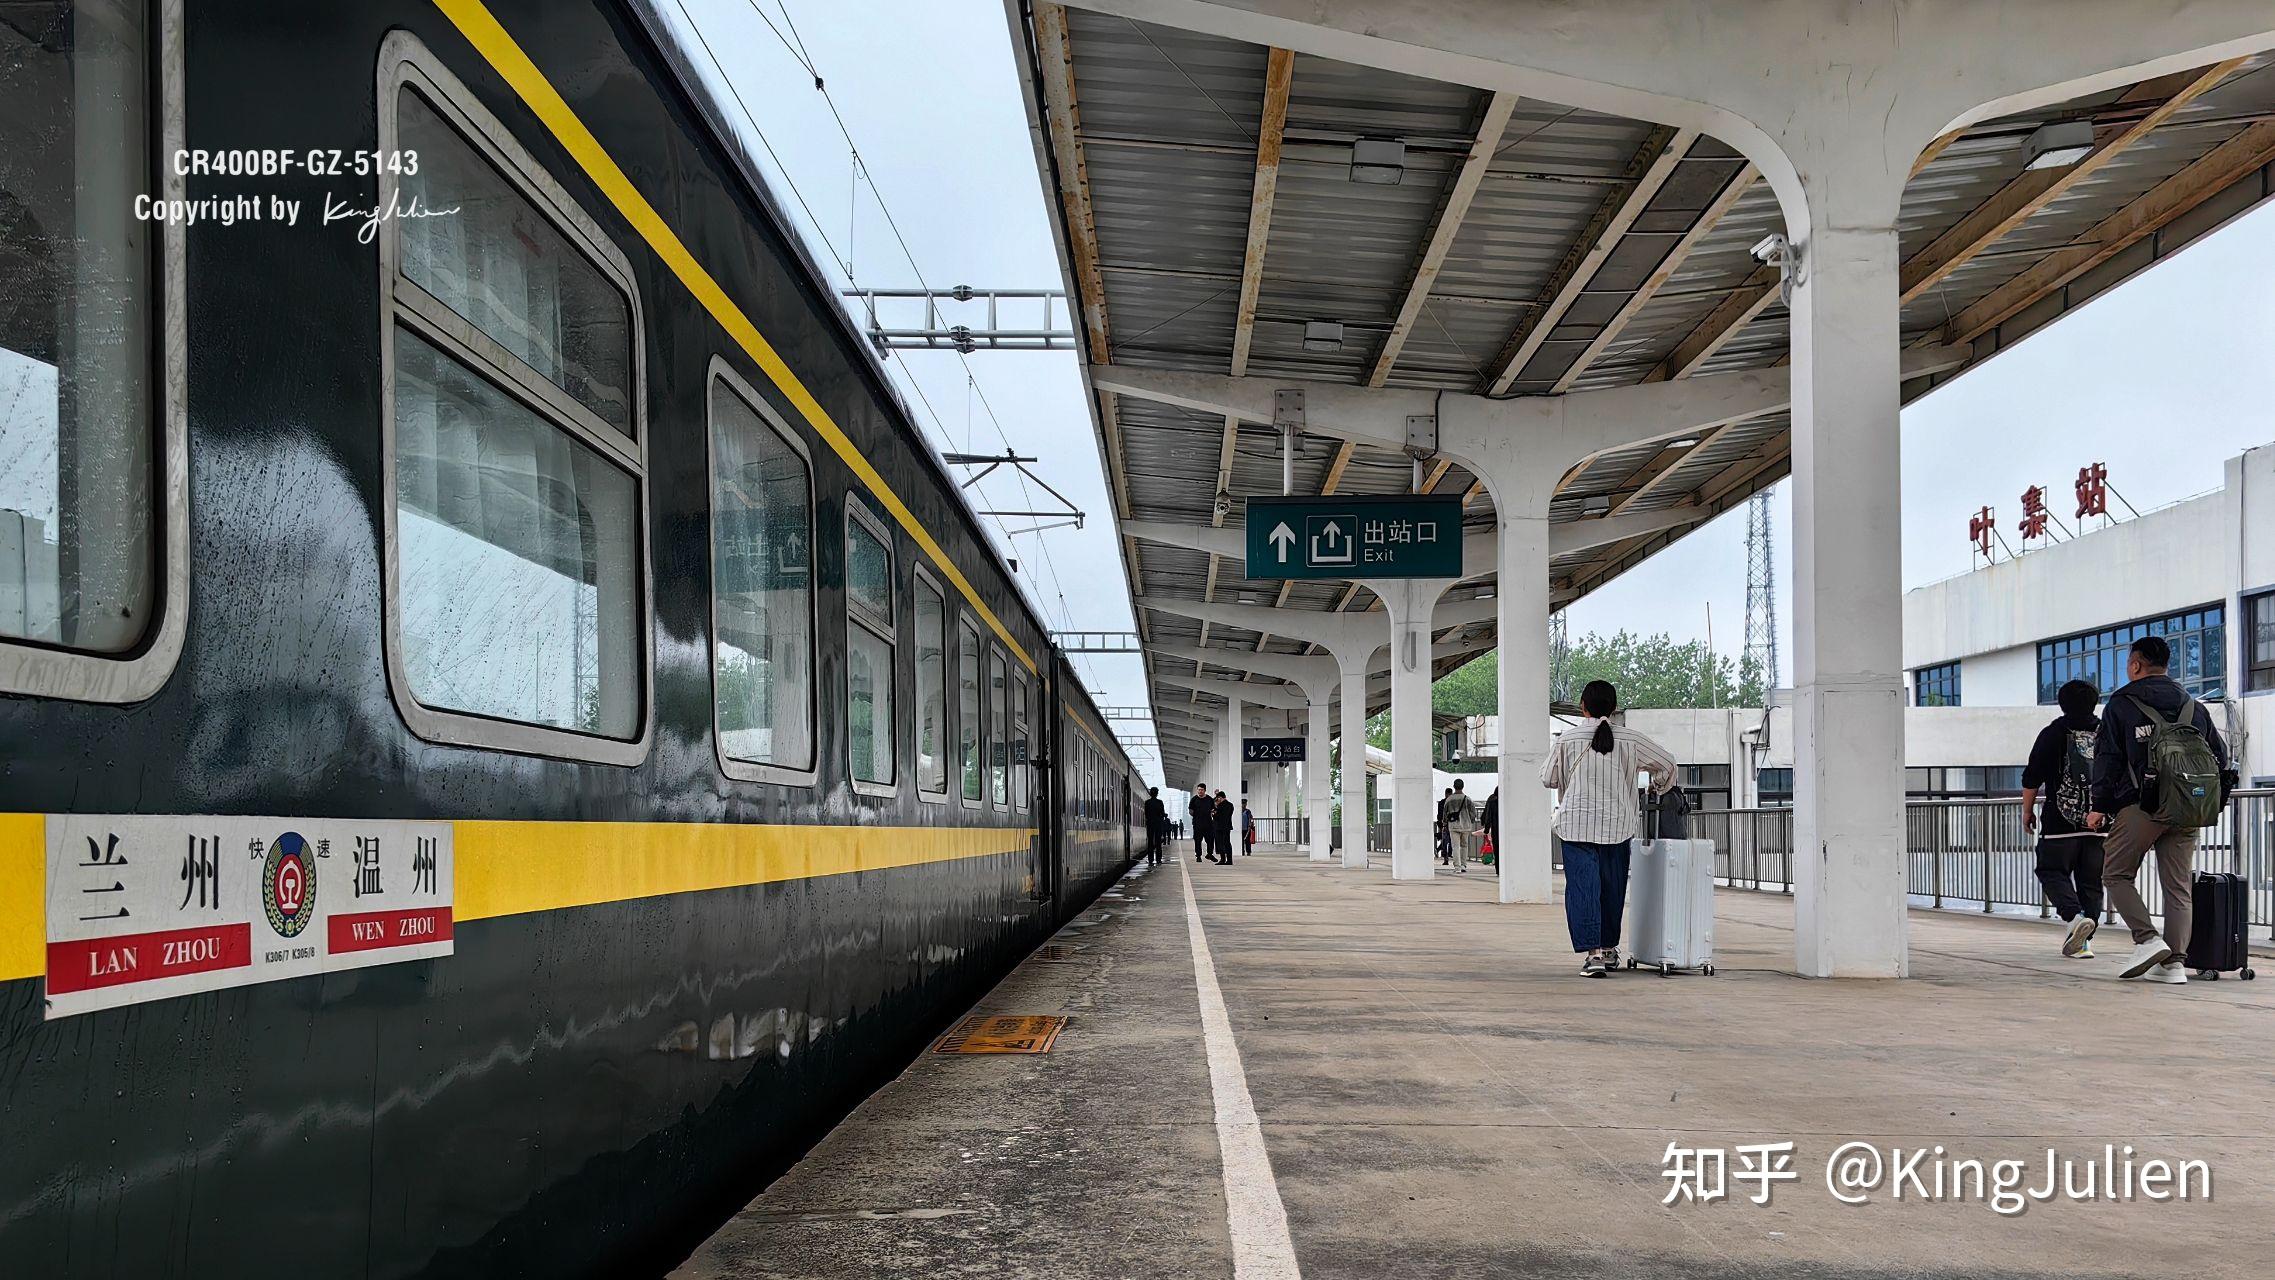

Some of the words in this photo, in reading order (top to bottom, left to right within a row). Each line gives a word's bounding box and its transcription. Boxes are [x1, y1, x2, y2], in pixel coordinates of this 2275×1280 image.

[1969, 462, 2107, 556] 叶集站
[1364, 519, 1437, 544] 出站口
[1364, 548, 1394, 562] Exit
[78, 832, 220, 921] 兰州
[248, 837, 265, 860] 快
[316, 837, 331, 860] 速
[352, 835, 437, 898] 温州
[352, 920, 385, 942] WEN
[399, 916, 436, 937] ZHOU
[89, 946, 139, 977] LAN
[162, 937, 222, 966] ZHOU
[265, 950, 290, 964] K306/7
[292, 946, 316, 960] K305/8
